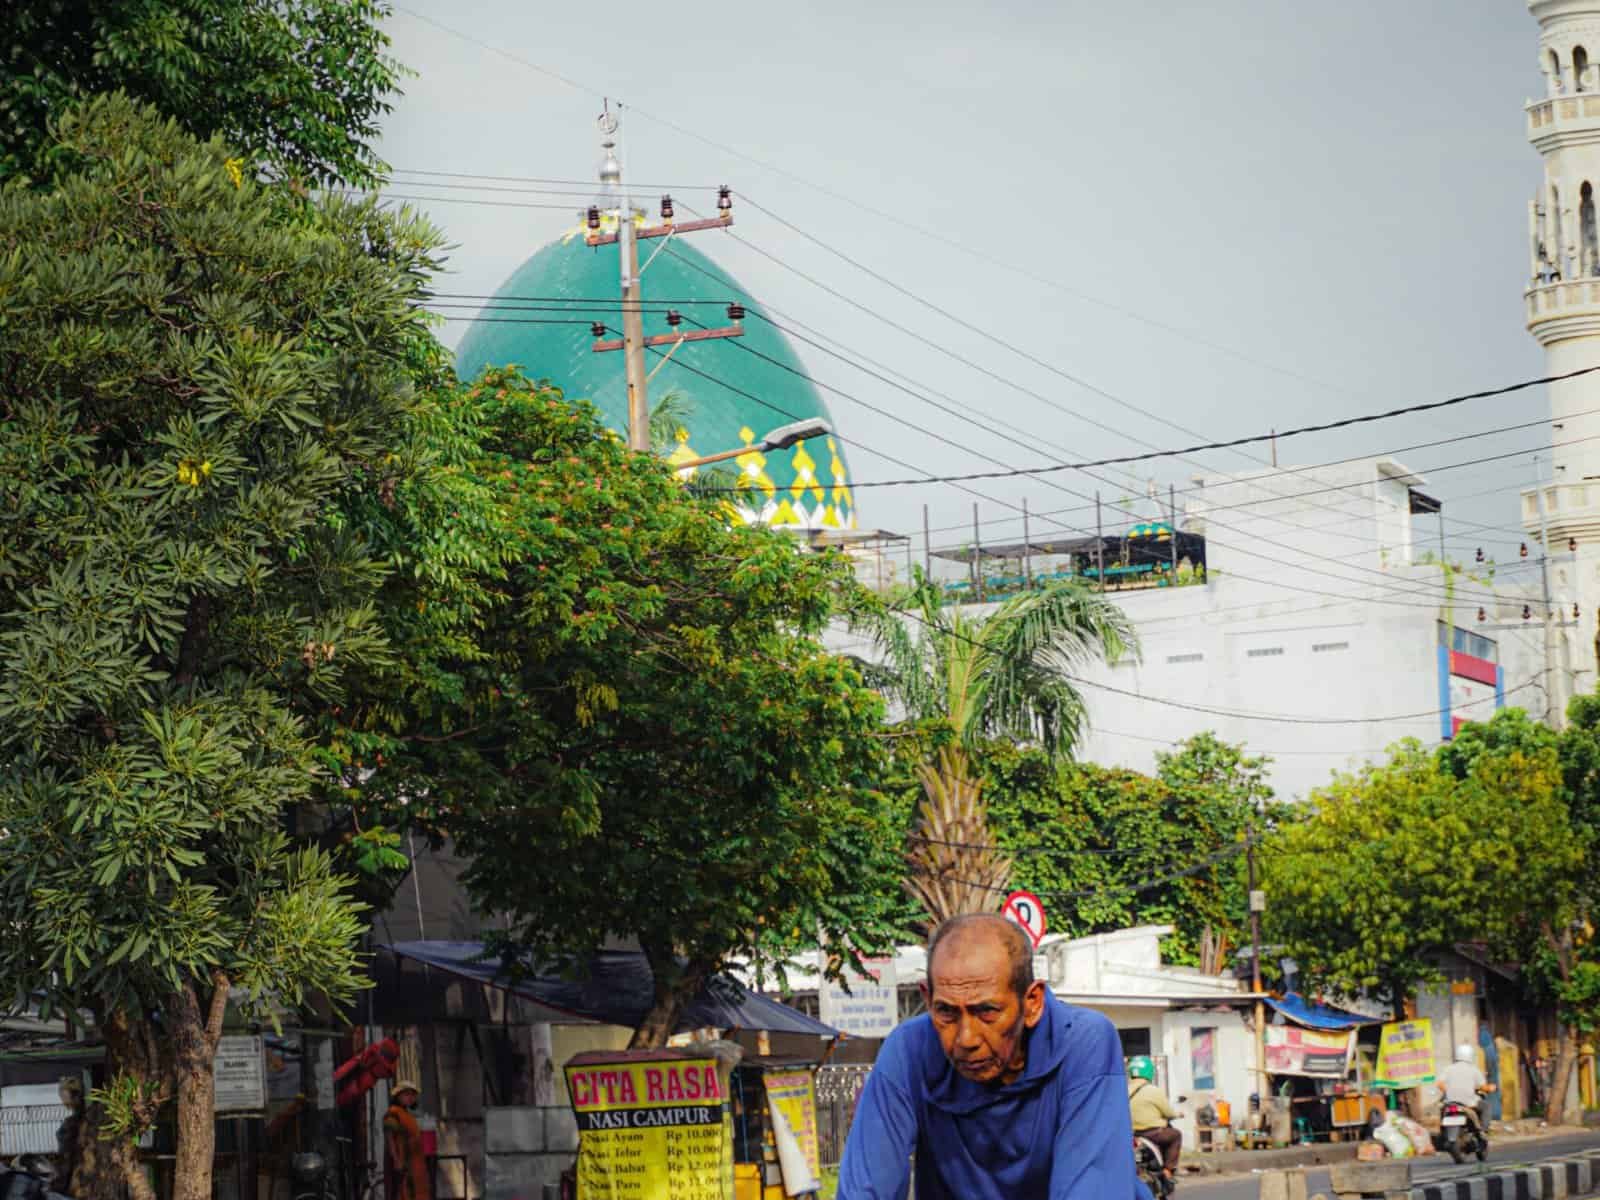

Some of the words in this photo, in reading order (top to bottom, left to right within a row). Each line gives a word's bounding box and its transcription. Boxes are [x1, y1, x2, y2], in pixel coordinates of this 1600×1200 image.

[572, 1070, 638, 1106] CITA
[645, 1065, 721, 1101] RASA
[588, 1111, 631, 1130] NASI
[633, 1107, 711, 1127] CAMPUR
[614, 1131, 644, 1144] Ayam
[666, 1130, 682, 1144] Rp
[667, 1146, 683, 1159] Rp
[668, 1161, 684, 1174] Rp
[669, 1177, 686, 1191] Rp
